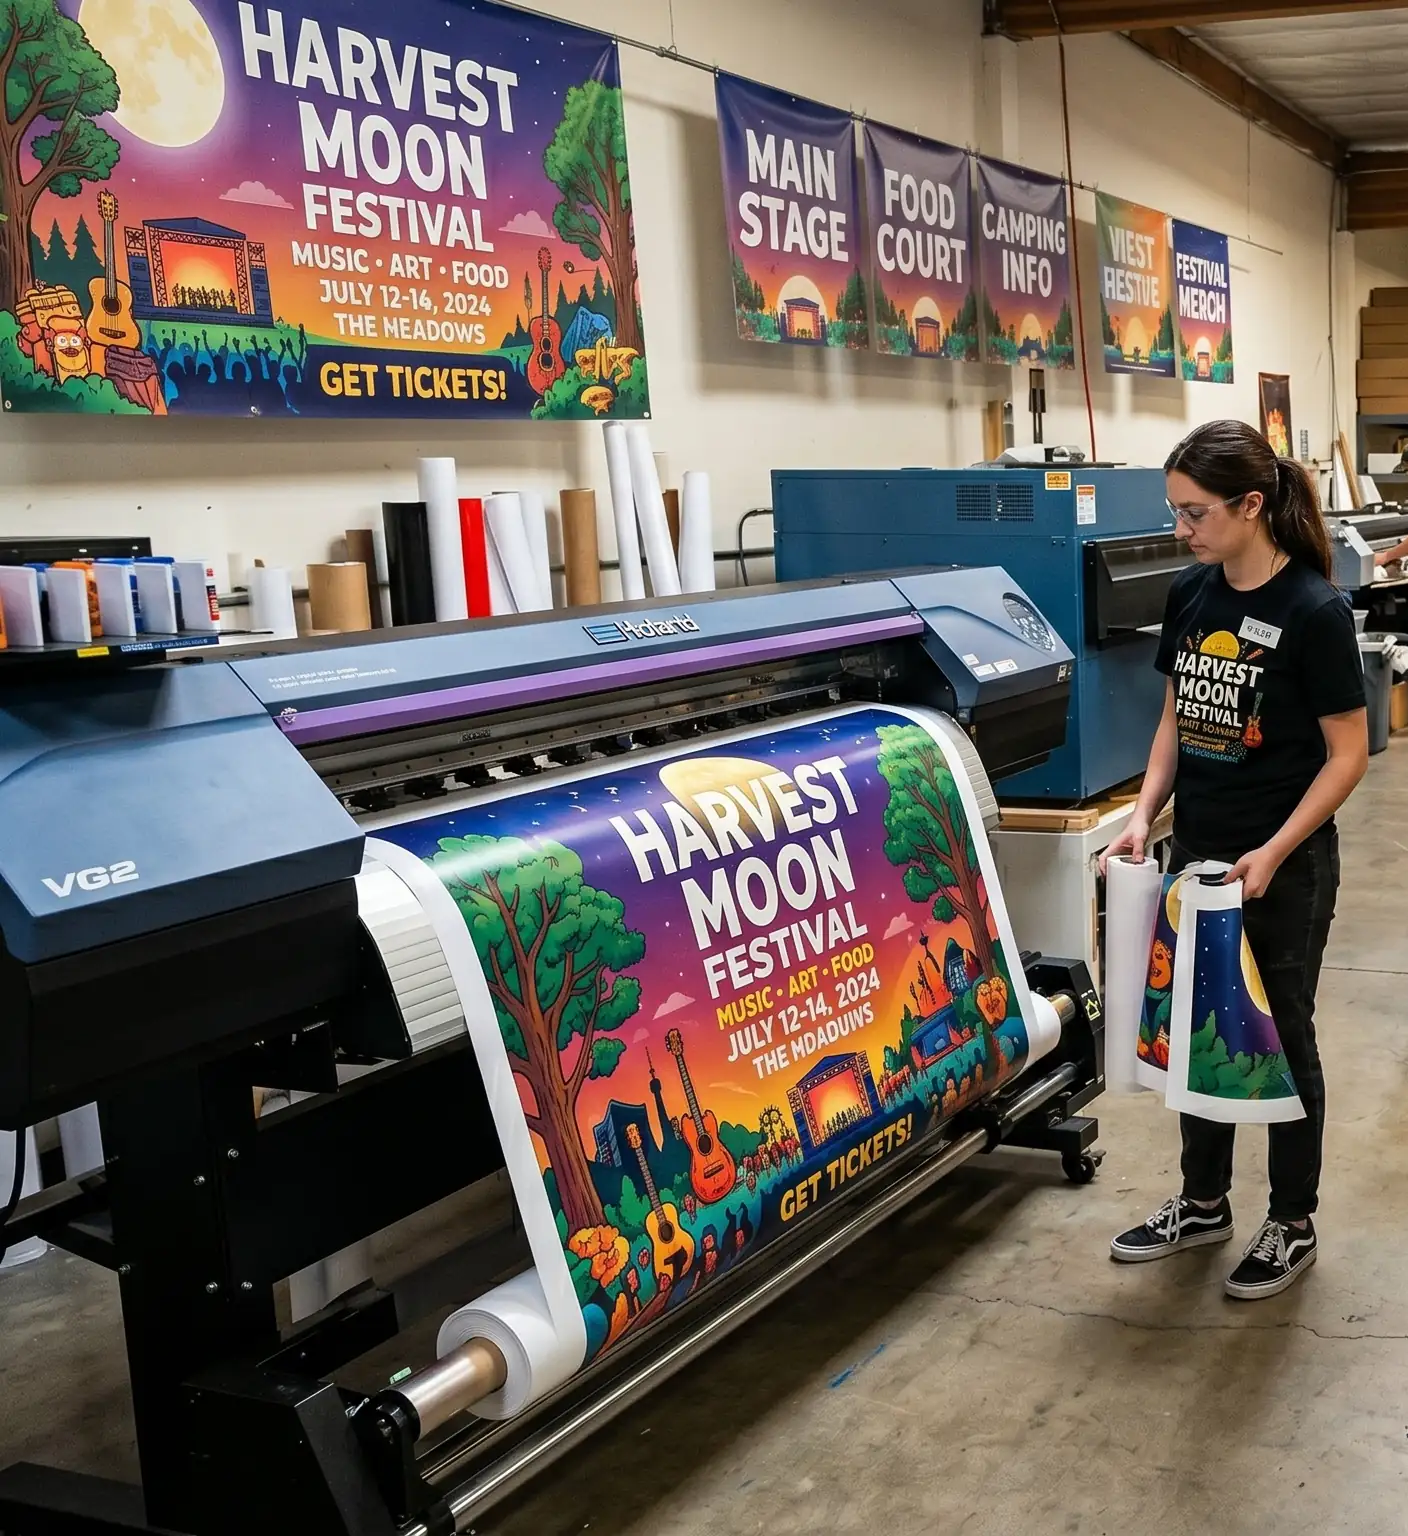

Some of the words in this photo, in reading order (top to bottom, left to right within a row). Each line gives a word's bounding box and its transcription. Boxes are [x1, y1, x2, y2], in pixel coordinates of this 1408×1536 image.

[238, 1, 518, 133] HARVEST
[299, 101, 487, 200] MOON
[746, 128, 837, 202] MAIN
[303, 183, 494, 252] FESTIVAL
[739, 191, 849, 262] STAGE
[884, 168, 955, 230] FOOD
[982, 202, 1065, 255] CAMPING
[292, 241, 370, 274] MUSIC
[389, 253, 433, 280] ART
[452, 261, 509, 289] FOOD
[877, 223, 966, 284] COURT
[1002, 249, 1052, 298] INFO
[1176, 252, 1228, 288] FESTIVAL
[319, 279, 374, 307] JULY
[443, 291, 492, 316] 2024
[333, 312, 378, 338] THE
[383, 316, 487, 345] MEADOWS
[320, 361, 378, 397] GET
[386, 365, 507, 401] TICKETS!
[1174, 650, 1264, 688] HARVEST
[1178, 675, 1240, 709] MOON
[1176, 698, 1243, 728] FESTIVAL
[608, 755, 859, 883] HARVEST
[40, 860, 140, 898] VG2
[680, 828, 856, 951] MOON
[703, 901, 868, 999] FESTIVAL
[716, 985, 774, 1031] MUSIC
[789, 965, 819, 998] ART
[830, 942, 875, 978] FOOD
[727, 1015, 773, 1062] JULY
[777, 991, 833, 1036] 12-14,
[835, 966, 881, 1009] 2024
[752, 1044, 790, 1080] THE
[780, 1170, 822, 1222] GET
[826, 1112, 913, 1191] TICKETS!
